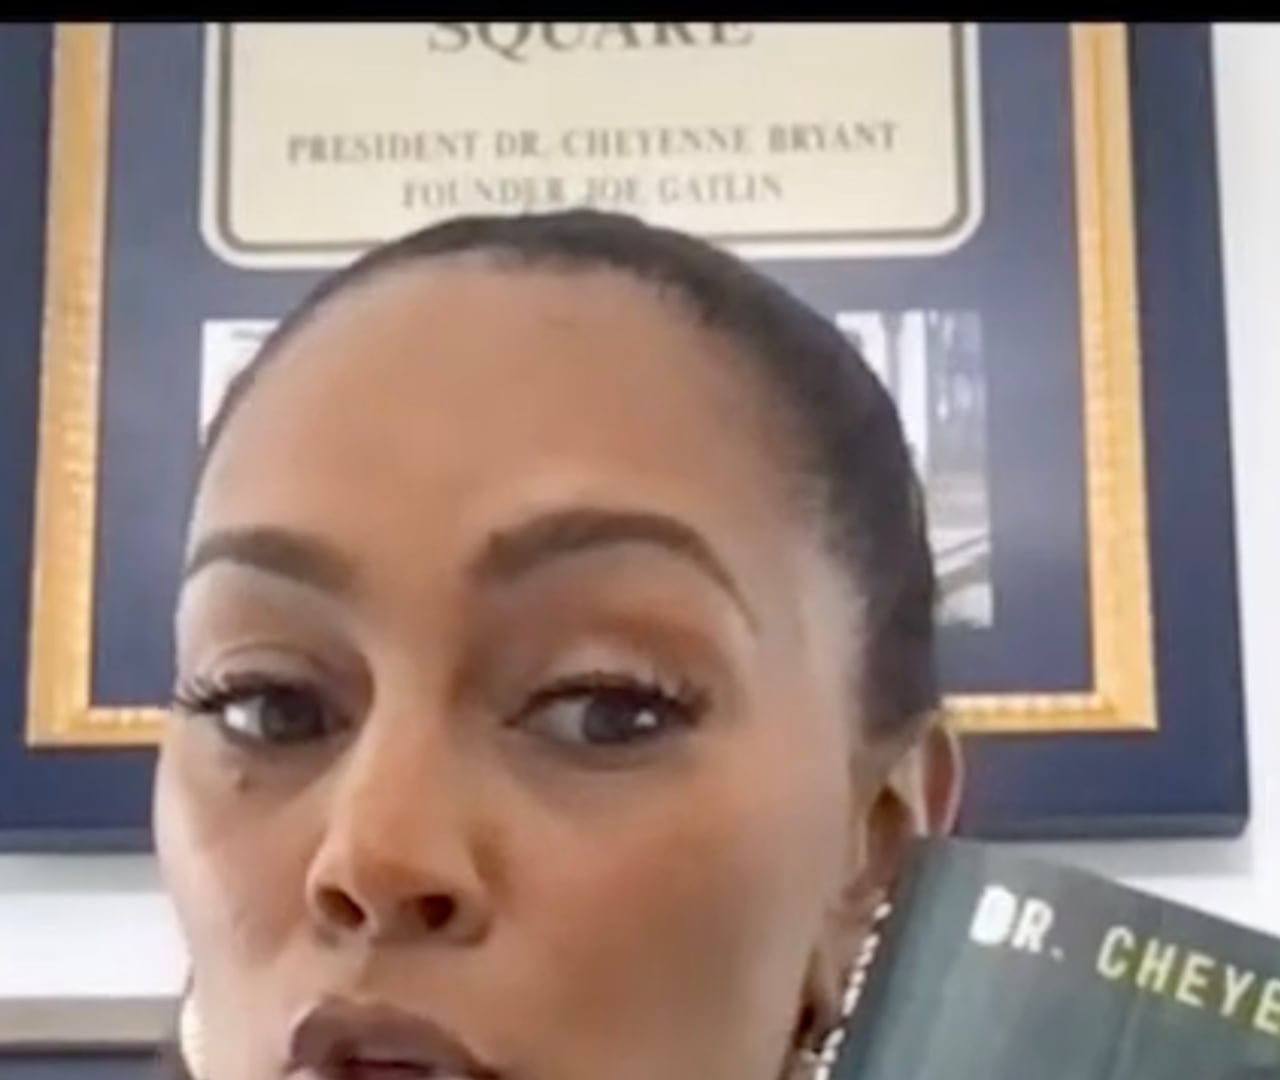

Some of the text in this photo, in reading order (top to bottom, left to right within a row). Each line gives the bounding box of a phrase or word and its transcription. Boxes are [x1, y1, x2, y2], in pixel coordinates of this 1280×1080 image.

[286, 130, 480, 165] PRESIDENT
[560, 126, 748, 158] CHEYENNE
[768, 121, 900, 154] BRYANT
[402, 177, 566, 209] FOUNDER
[657, 172, 784, 203] GATLIN
[968, 884, 1065, 962] DR.
